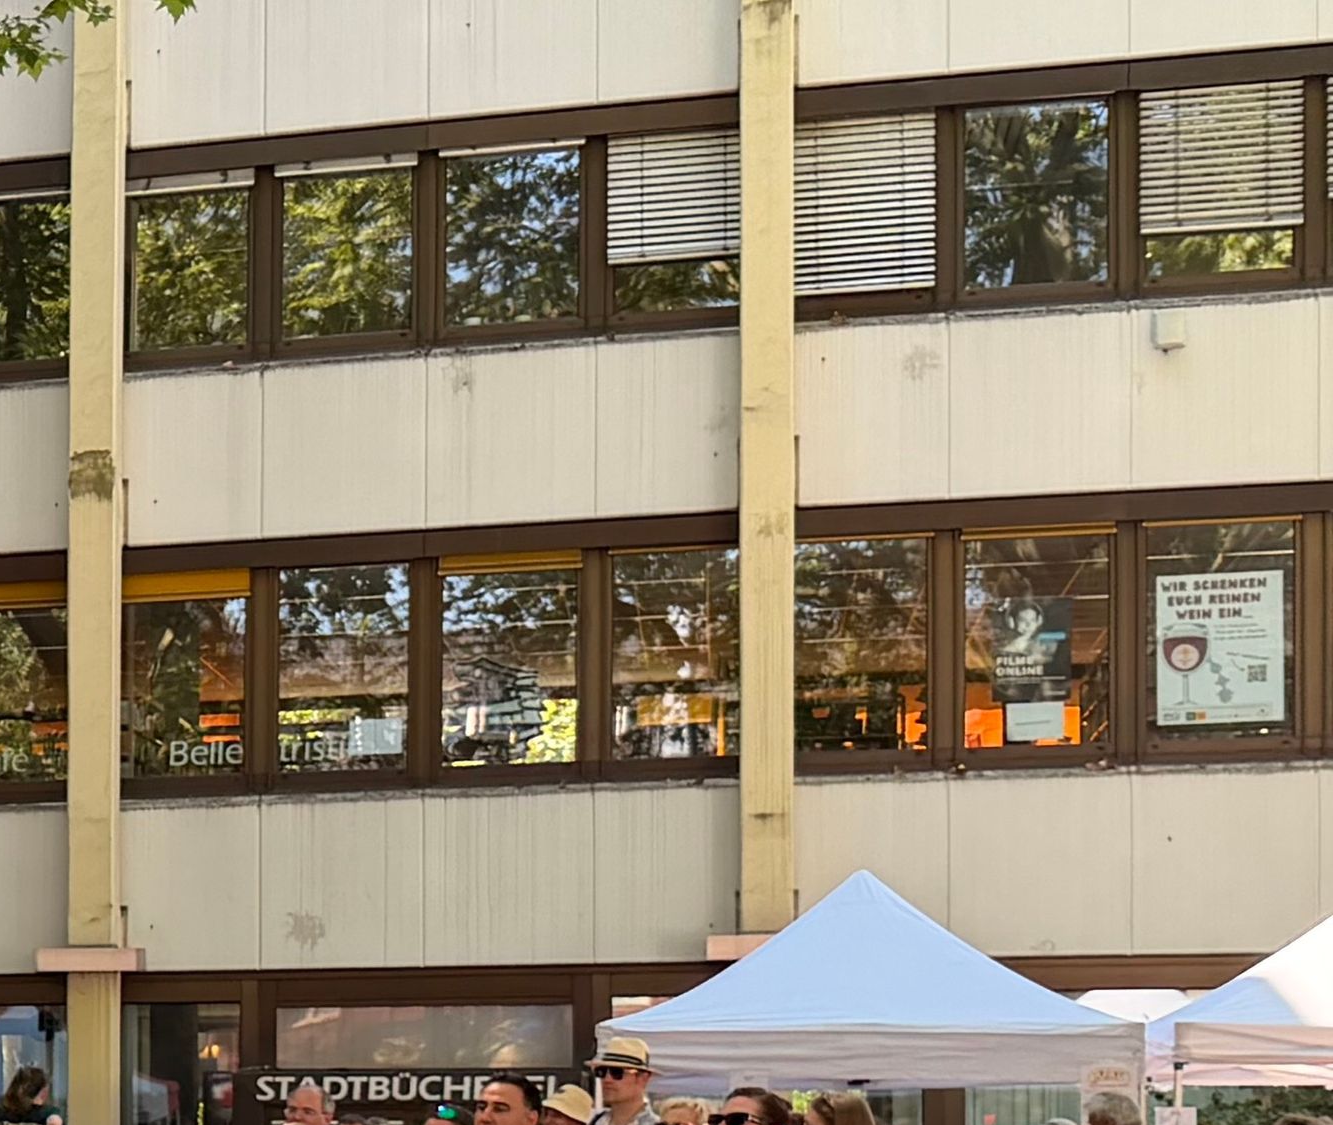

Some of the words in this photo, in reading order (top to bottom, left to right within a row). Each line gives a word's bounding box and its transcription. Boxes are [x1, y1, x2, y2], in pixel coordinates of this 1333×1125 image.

[1161, 581, 1187, 592] WIR
[1193, 577, 1267, 590] SCHENKEN
[1168, 595, 1202, 607] EUCH
[1209, 593, 1261, 605] REINEN
[1176, 608, 1212, 620] WEIN
[996, 665, 1044, 676] ONLINE
[169, 740, 243, 767] Belle
